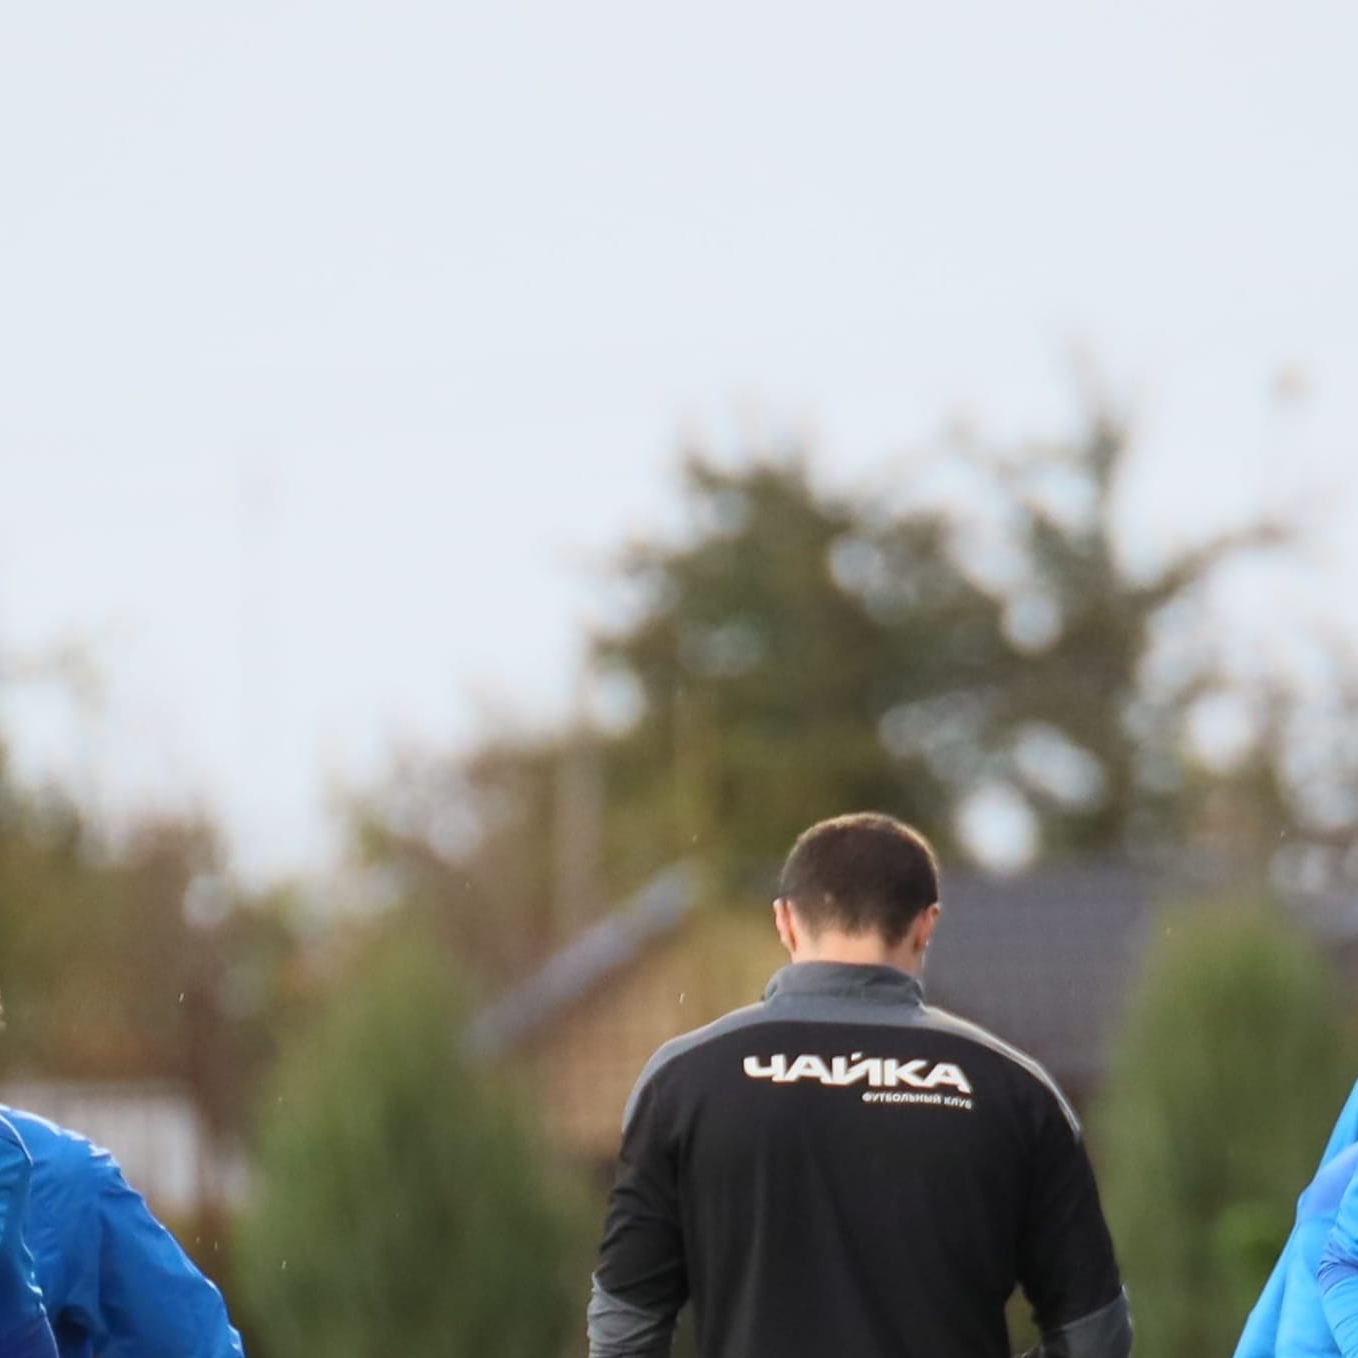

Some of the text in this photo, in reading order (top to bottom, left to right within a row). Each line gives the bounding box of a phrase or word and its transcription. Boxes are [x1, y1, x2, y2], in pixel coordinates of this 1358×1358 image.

[743, 1051, 973, 1094] ЧАЙКА
[862, 1091, 972, 1110] ФУТБОЛЬНЫЙ КЛУБ
